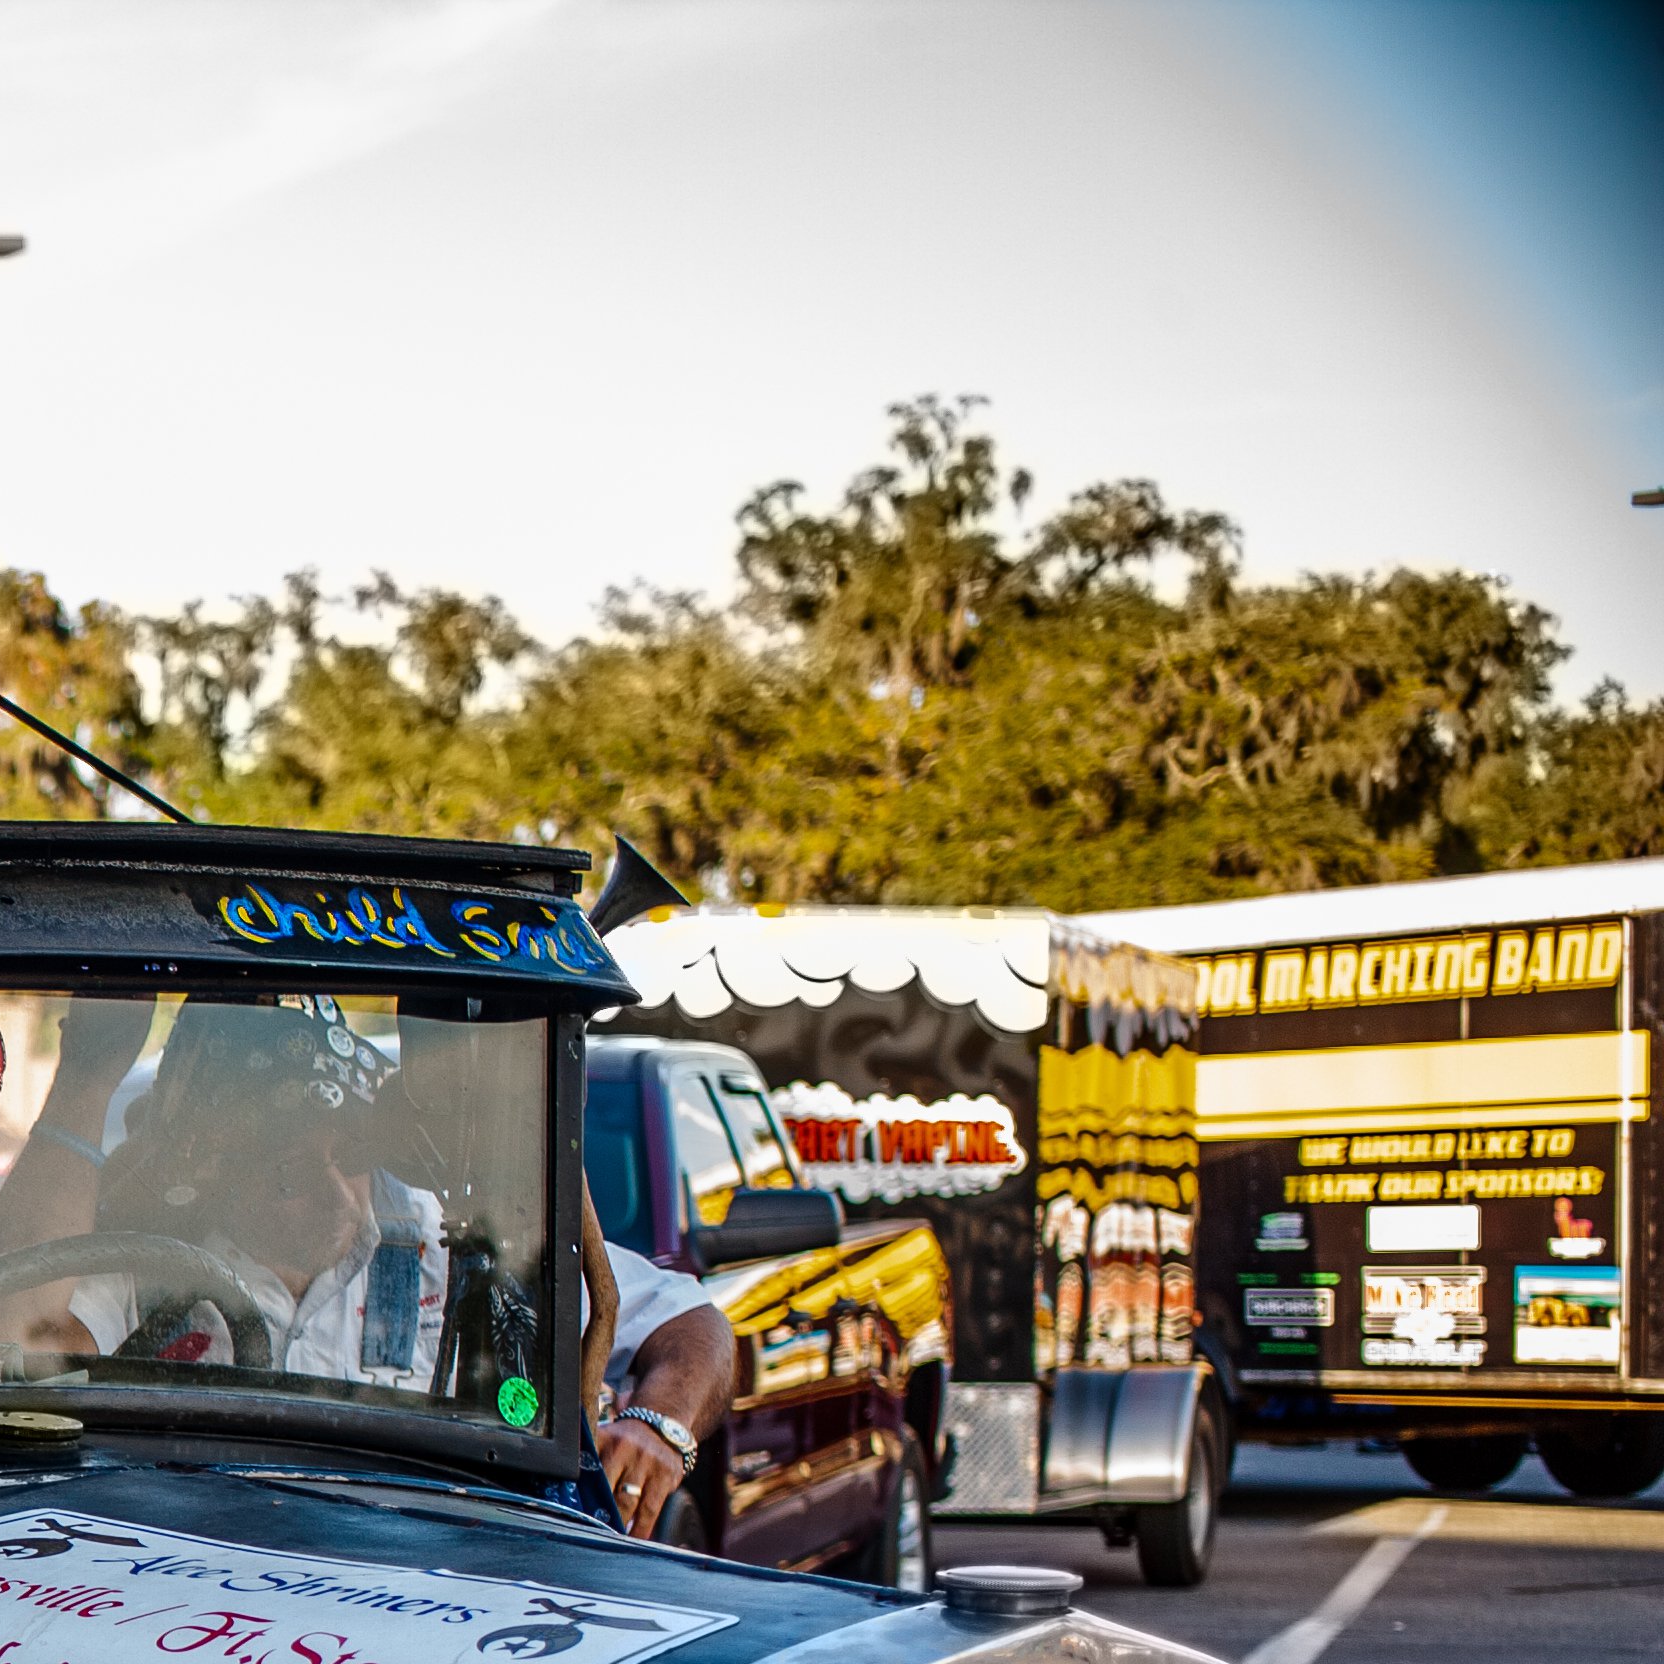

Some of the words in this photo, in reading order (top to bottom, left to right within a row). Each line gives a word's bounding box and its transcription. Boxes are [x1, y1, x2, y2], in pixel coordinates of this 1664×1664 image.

[1259, 932, 1493, 1015] MARCHING
[1491, 921, 1623, 997] BAND
[1348, 1132, 1457, 1165] WOULD
[1531, 1128, 1576, 1158] TO
[1283, 1173, 1379, 1204] THANK
[1377, 1170, 1444, 1201] OUR
[93, 1553, 219, 1583] Alee
[220, 1569, 490, 1626] Shriners
